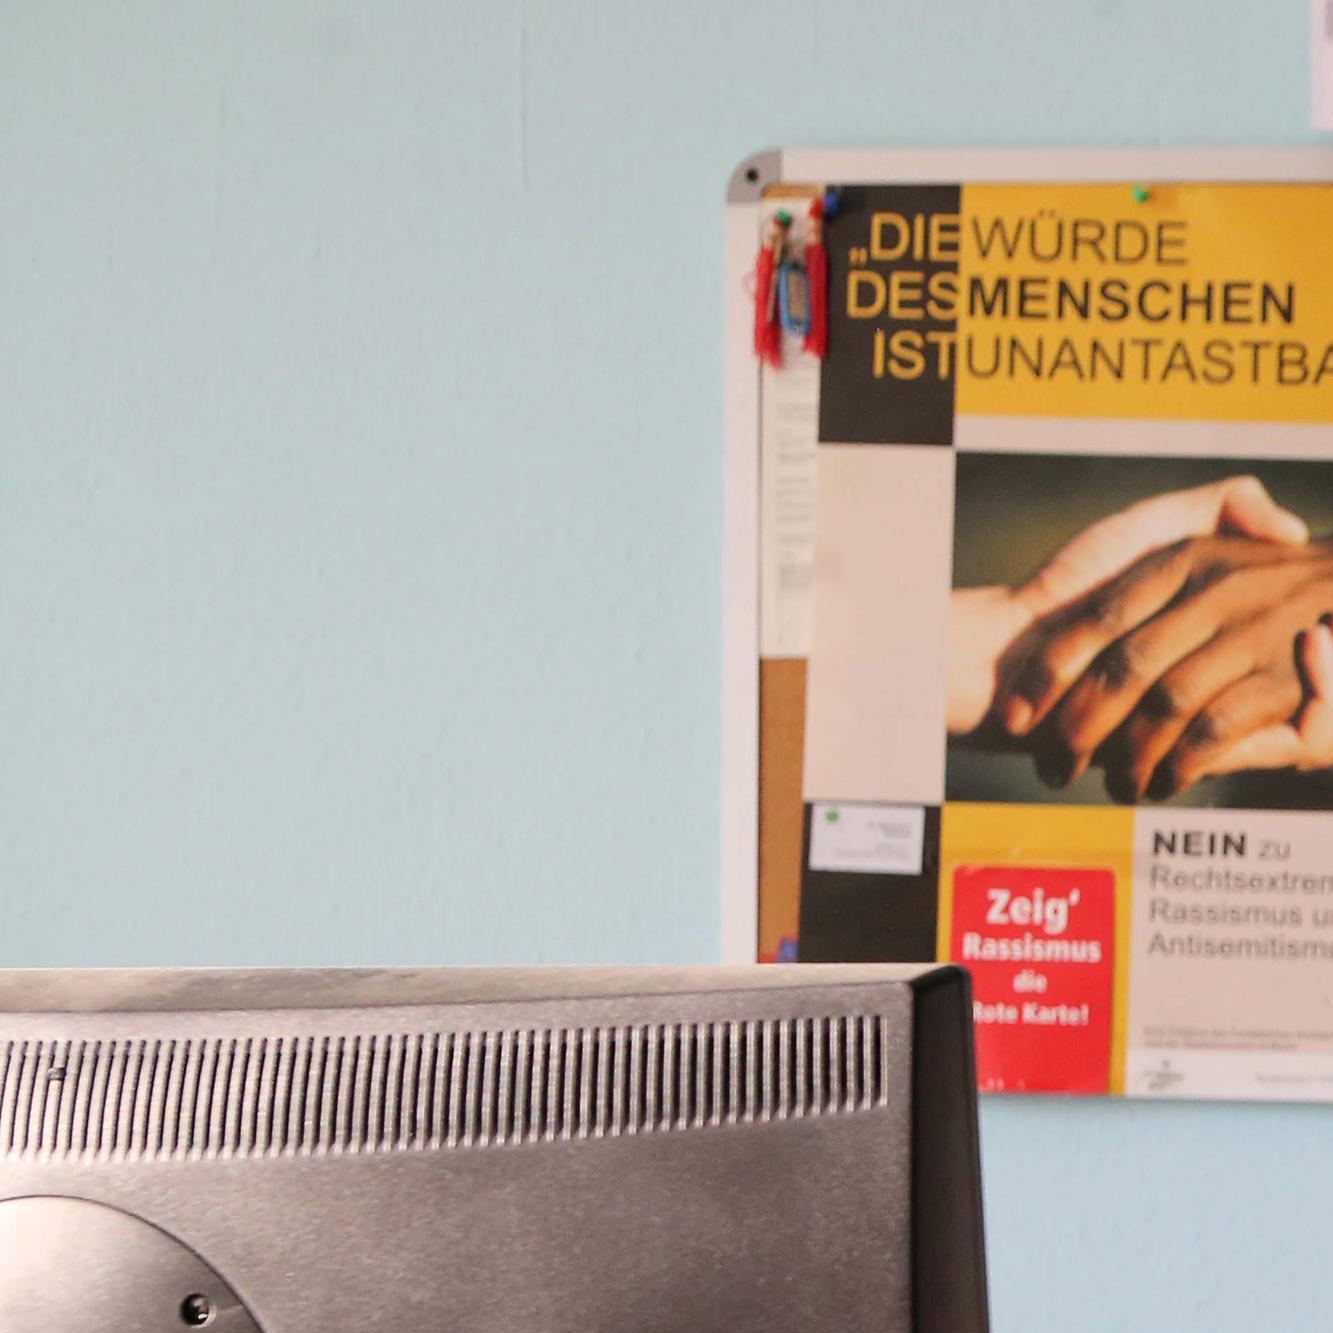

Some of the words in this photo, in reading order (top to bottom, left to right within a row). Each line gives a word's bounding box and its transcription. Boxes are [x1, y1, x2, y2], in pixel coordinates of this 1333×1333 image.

[971, 208, 1188, 266] WÜRDE
[846, 269, 959, 320] DES
[968, 275, 1296, 325] MENSCHEN
[872, 328, 956, 381] IST
[1152, 830, 1248, 858] NEIN
[1258, 840, 1292, 861] zu
[1149, 898, 1304, 926] Rassismus
[963, 931, 1102, 963] Rassismus
[1012, 969, 1048, 993] die
[1022, 1002, 1089, 1026] Karte!
